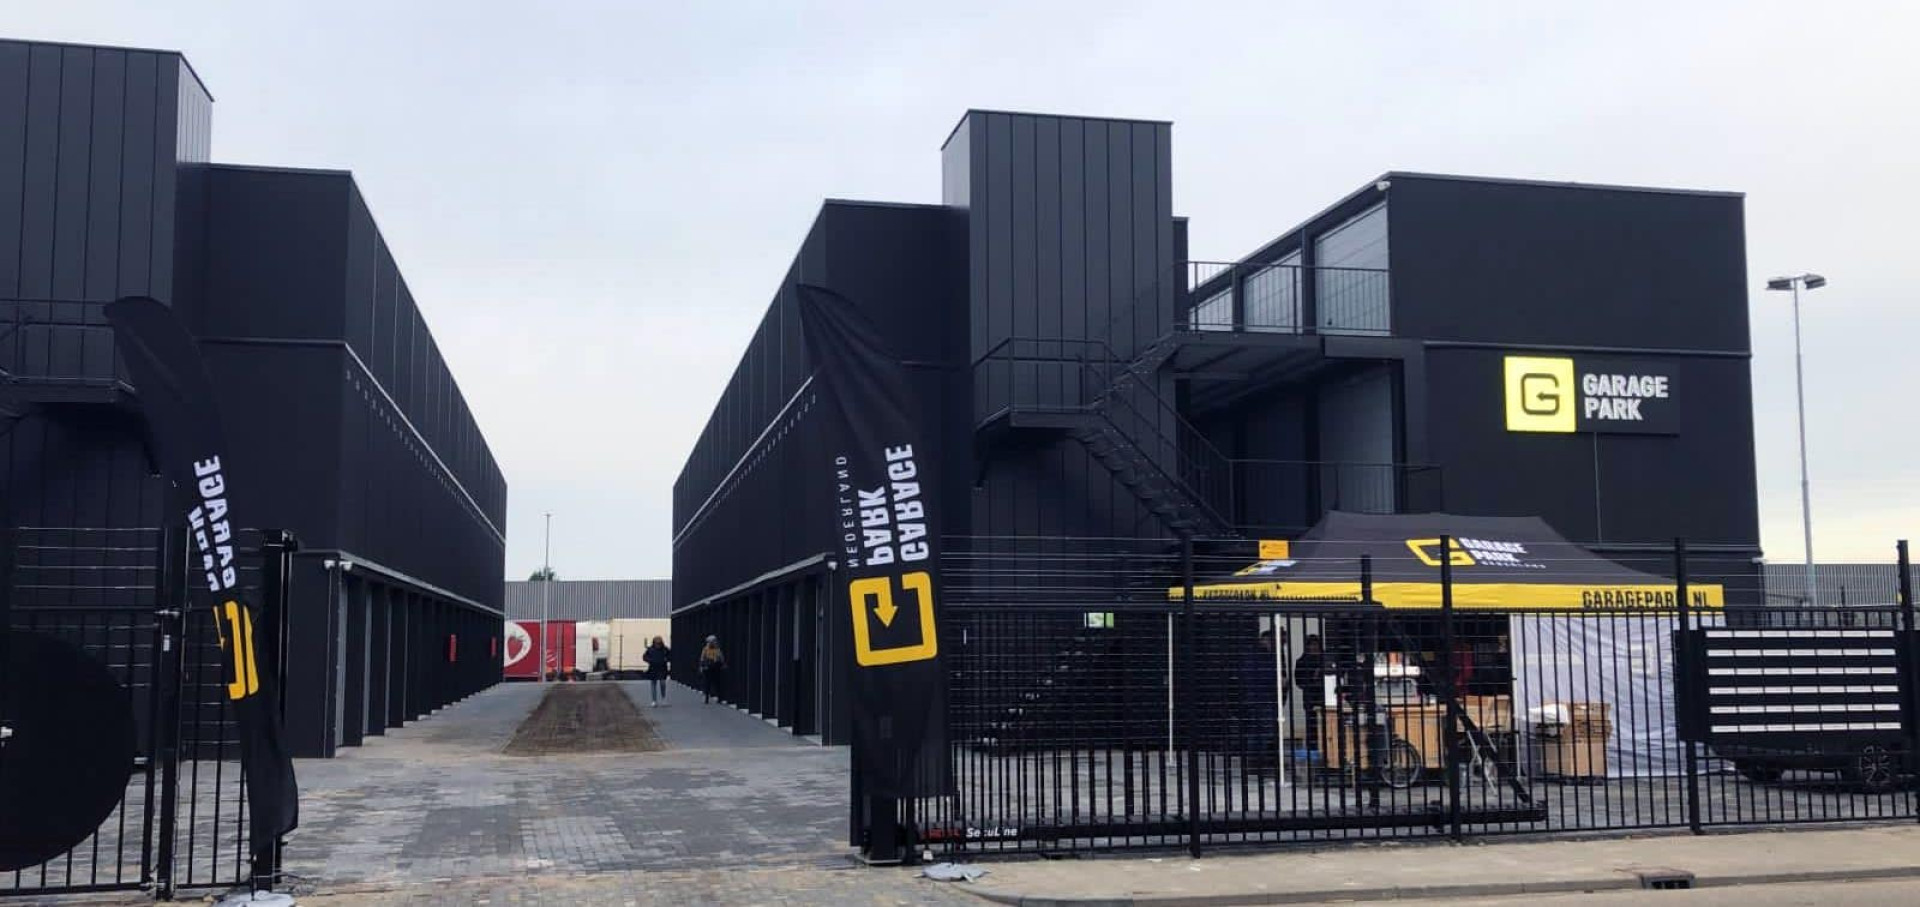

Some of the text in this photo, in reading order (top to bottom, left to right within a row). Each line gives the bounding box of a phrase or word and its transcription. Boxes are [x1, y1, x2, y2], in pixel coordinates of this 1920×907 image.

[1583, 374, 1669, 398] GARAGE
[1585, 397, 1643, 420] PARK
[1459, 537, 1527, 553] GARAGE
[1470, 550, 1521, 563] PARK
